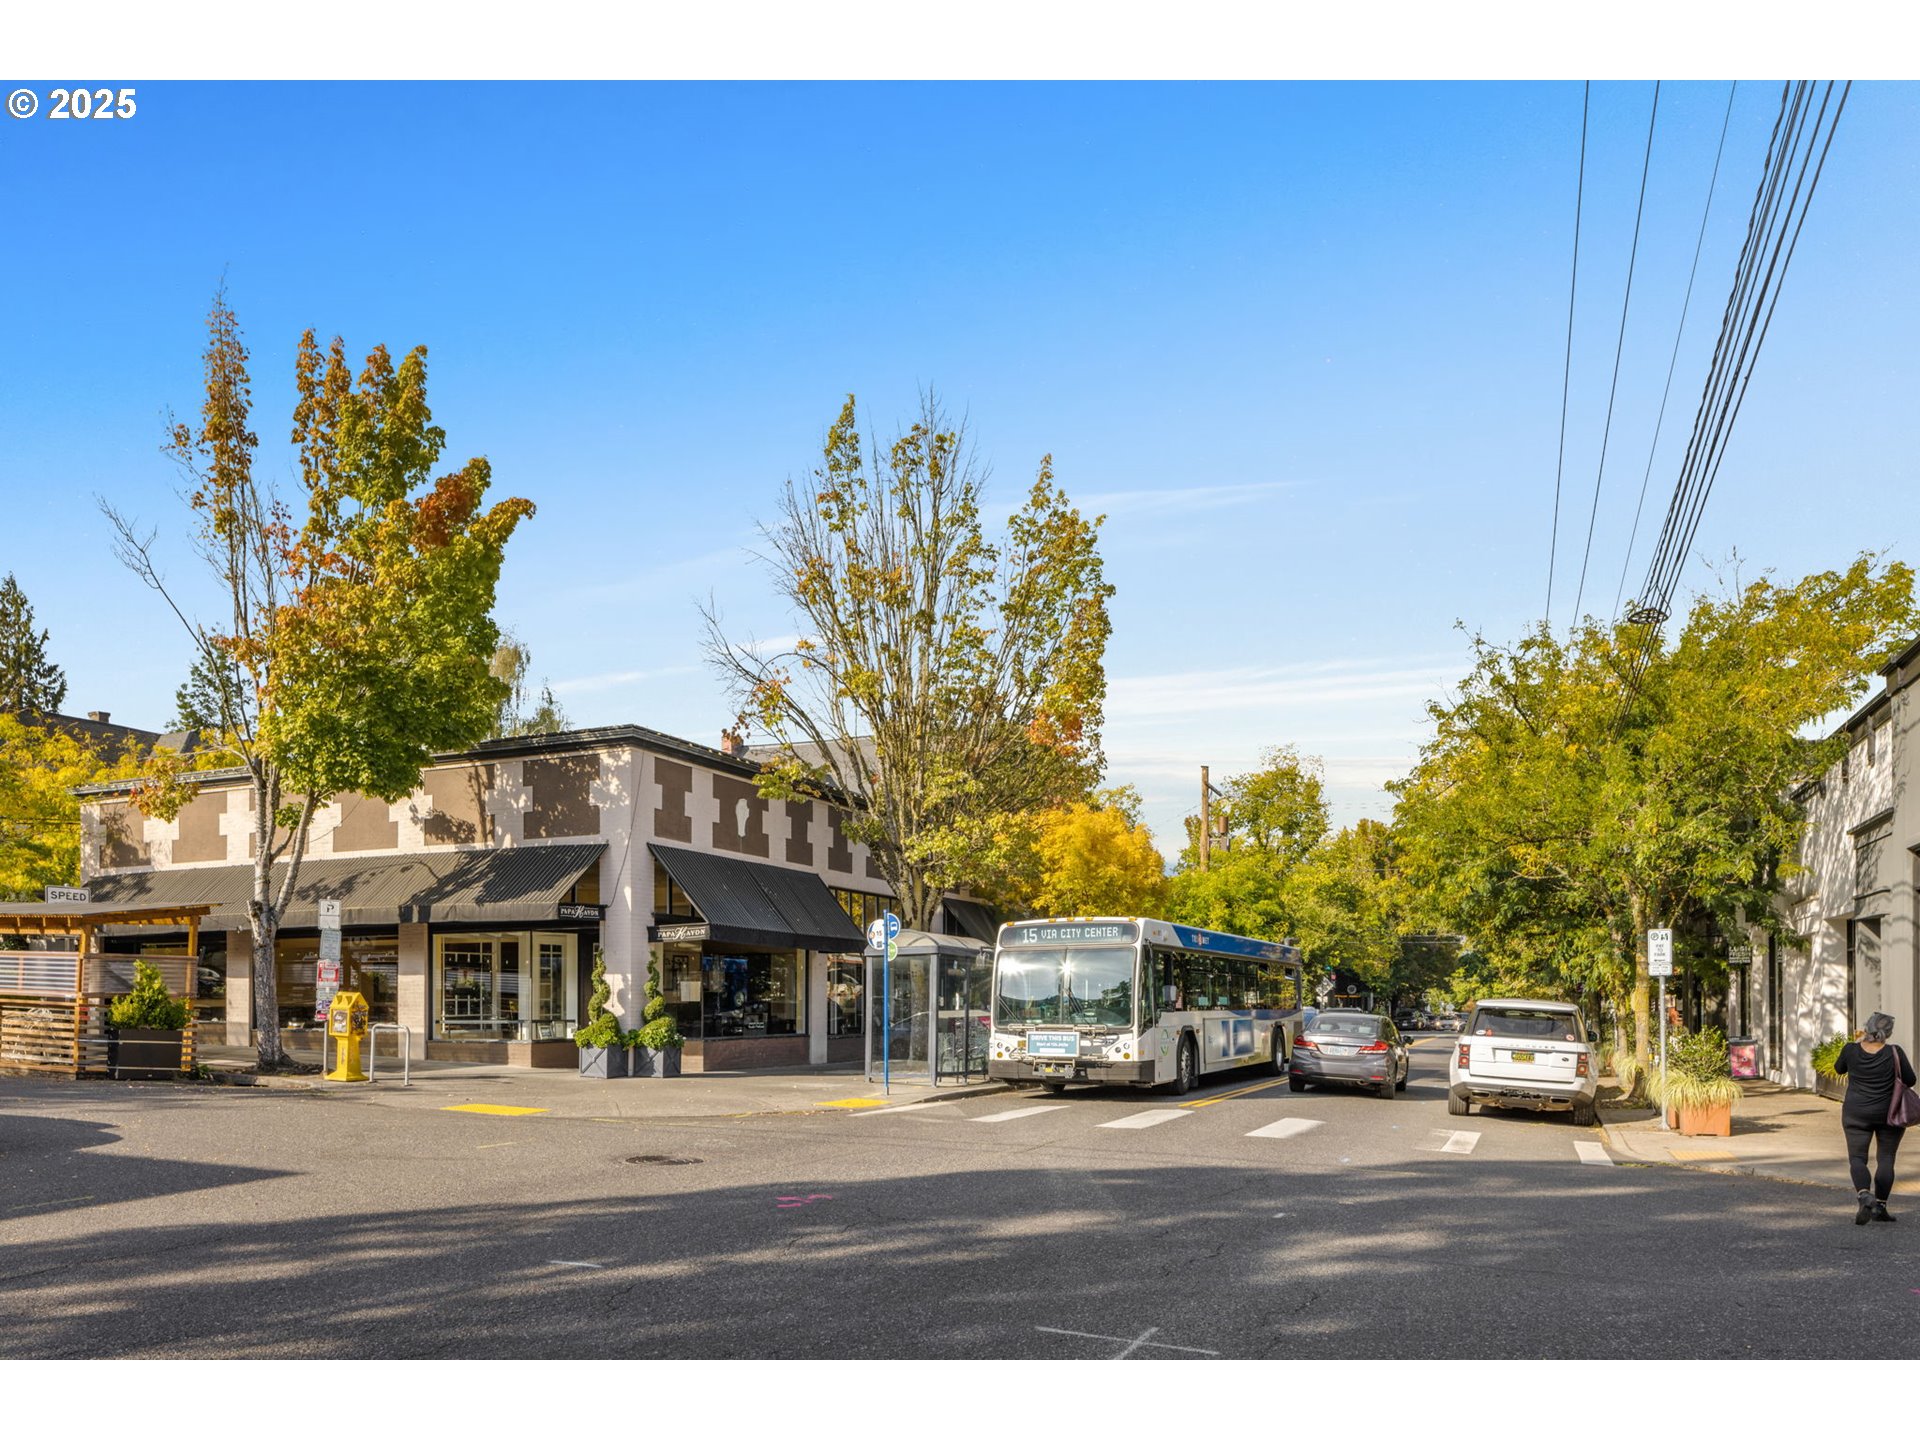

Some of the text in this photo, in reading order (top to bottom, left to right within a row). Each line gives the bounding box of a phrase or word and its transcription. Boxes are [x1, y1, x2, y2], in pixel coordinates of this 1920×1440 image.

[50, 891, 87, 901] SPEED
[657, 931, 675, 939] PAPA
[1022, 927, 1119, 943] 15 VIA CITY CENTER
